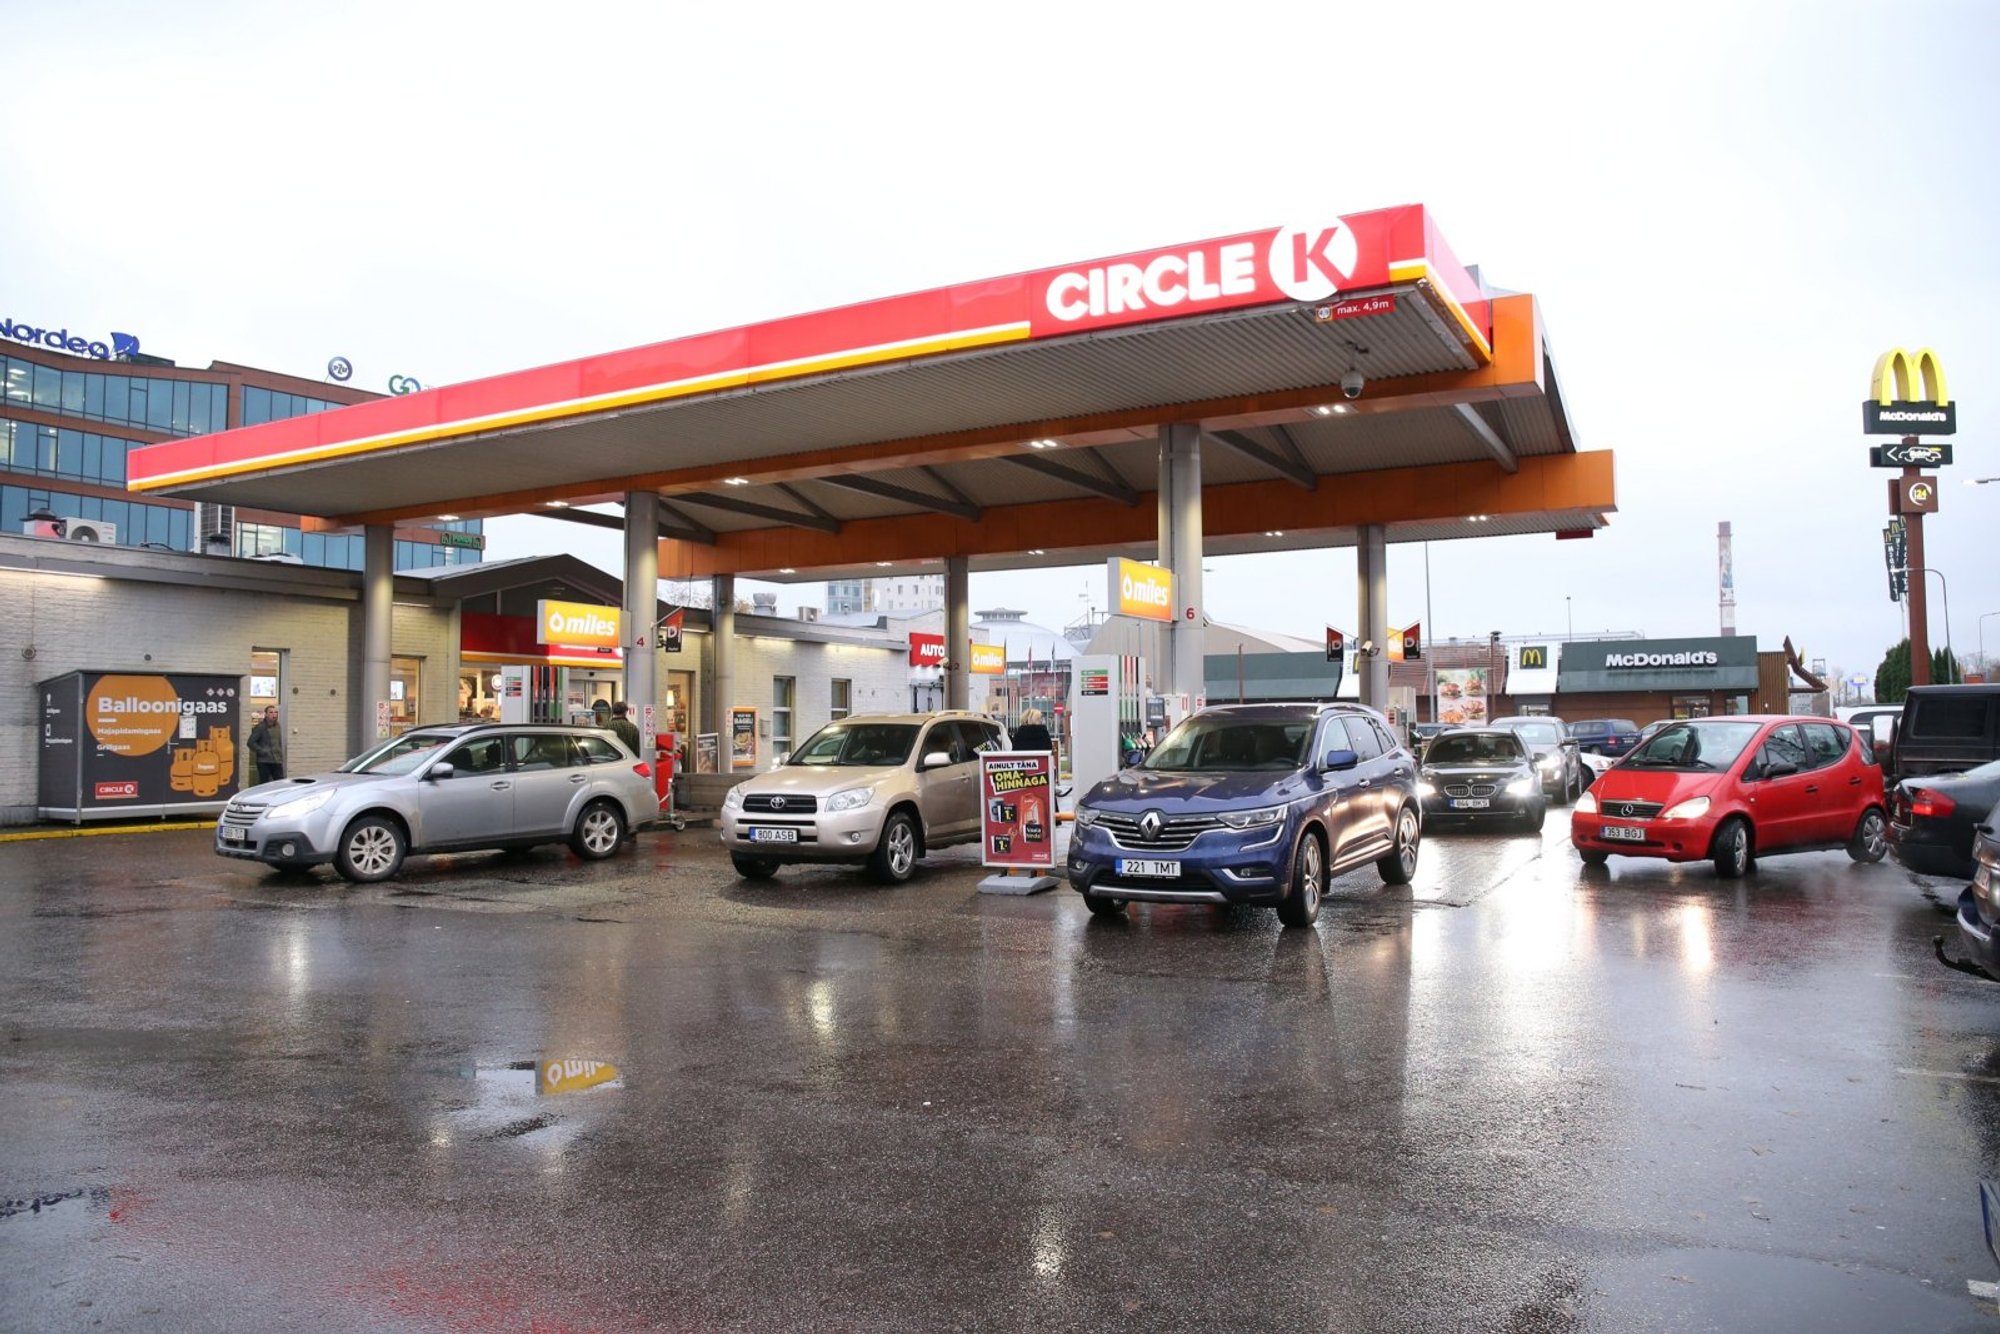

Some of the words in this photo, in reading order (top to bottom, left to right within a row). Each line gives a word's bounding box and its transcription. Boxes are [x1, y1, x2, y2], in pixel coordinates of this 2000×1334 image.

[1046, 242, 1257, 321] CIRCLE
[1287, 222, 1352, 296] K
[1337, 305, 1361, 315] max.
[1879, 411, 1947, 421] McDonald's
[1132, 578, 1168, 607] miles
[1186, 608, 1195, 619] 6
[565, 613, 616, 636] miles
[637, 636, 645, 647] 4
[981, 653, 1003, 666] miles
[1605, 651, 1718, 667] McDonald's
[98, 697, 228, 716] Balloonigaas
[97, 727, 162, 736] Majapidamisgaas
[97, 744, 131, 753] Grillgaas
[995, 771, 1024, 782] OMA-
[996, 776, 1048, 790] HINNAGA
[99, 786, 123, 794] CIRCLE
[758, 830, 773, 839] 800
[775, 831, 794, 840] ASB
[1624, 829, 1642, 838] BGJ
[1127, 861, 1145, 873] 221
[1153, 862, 1176, 874] TMT
